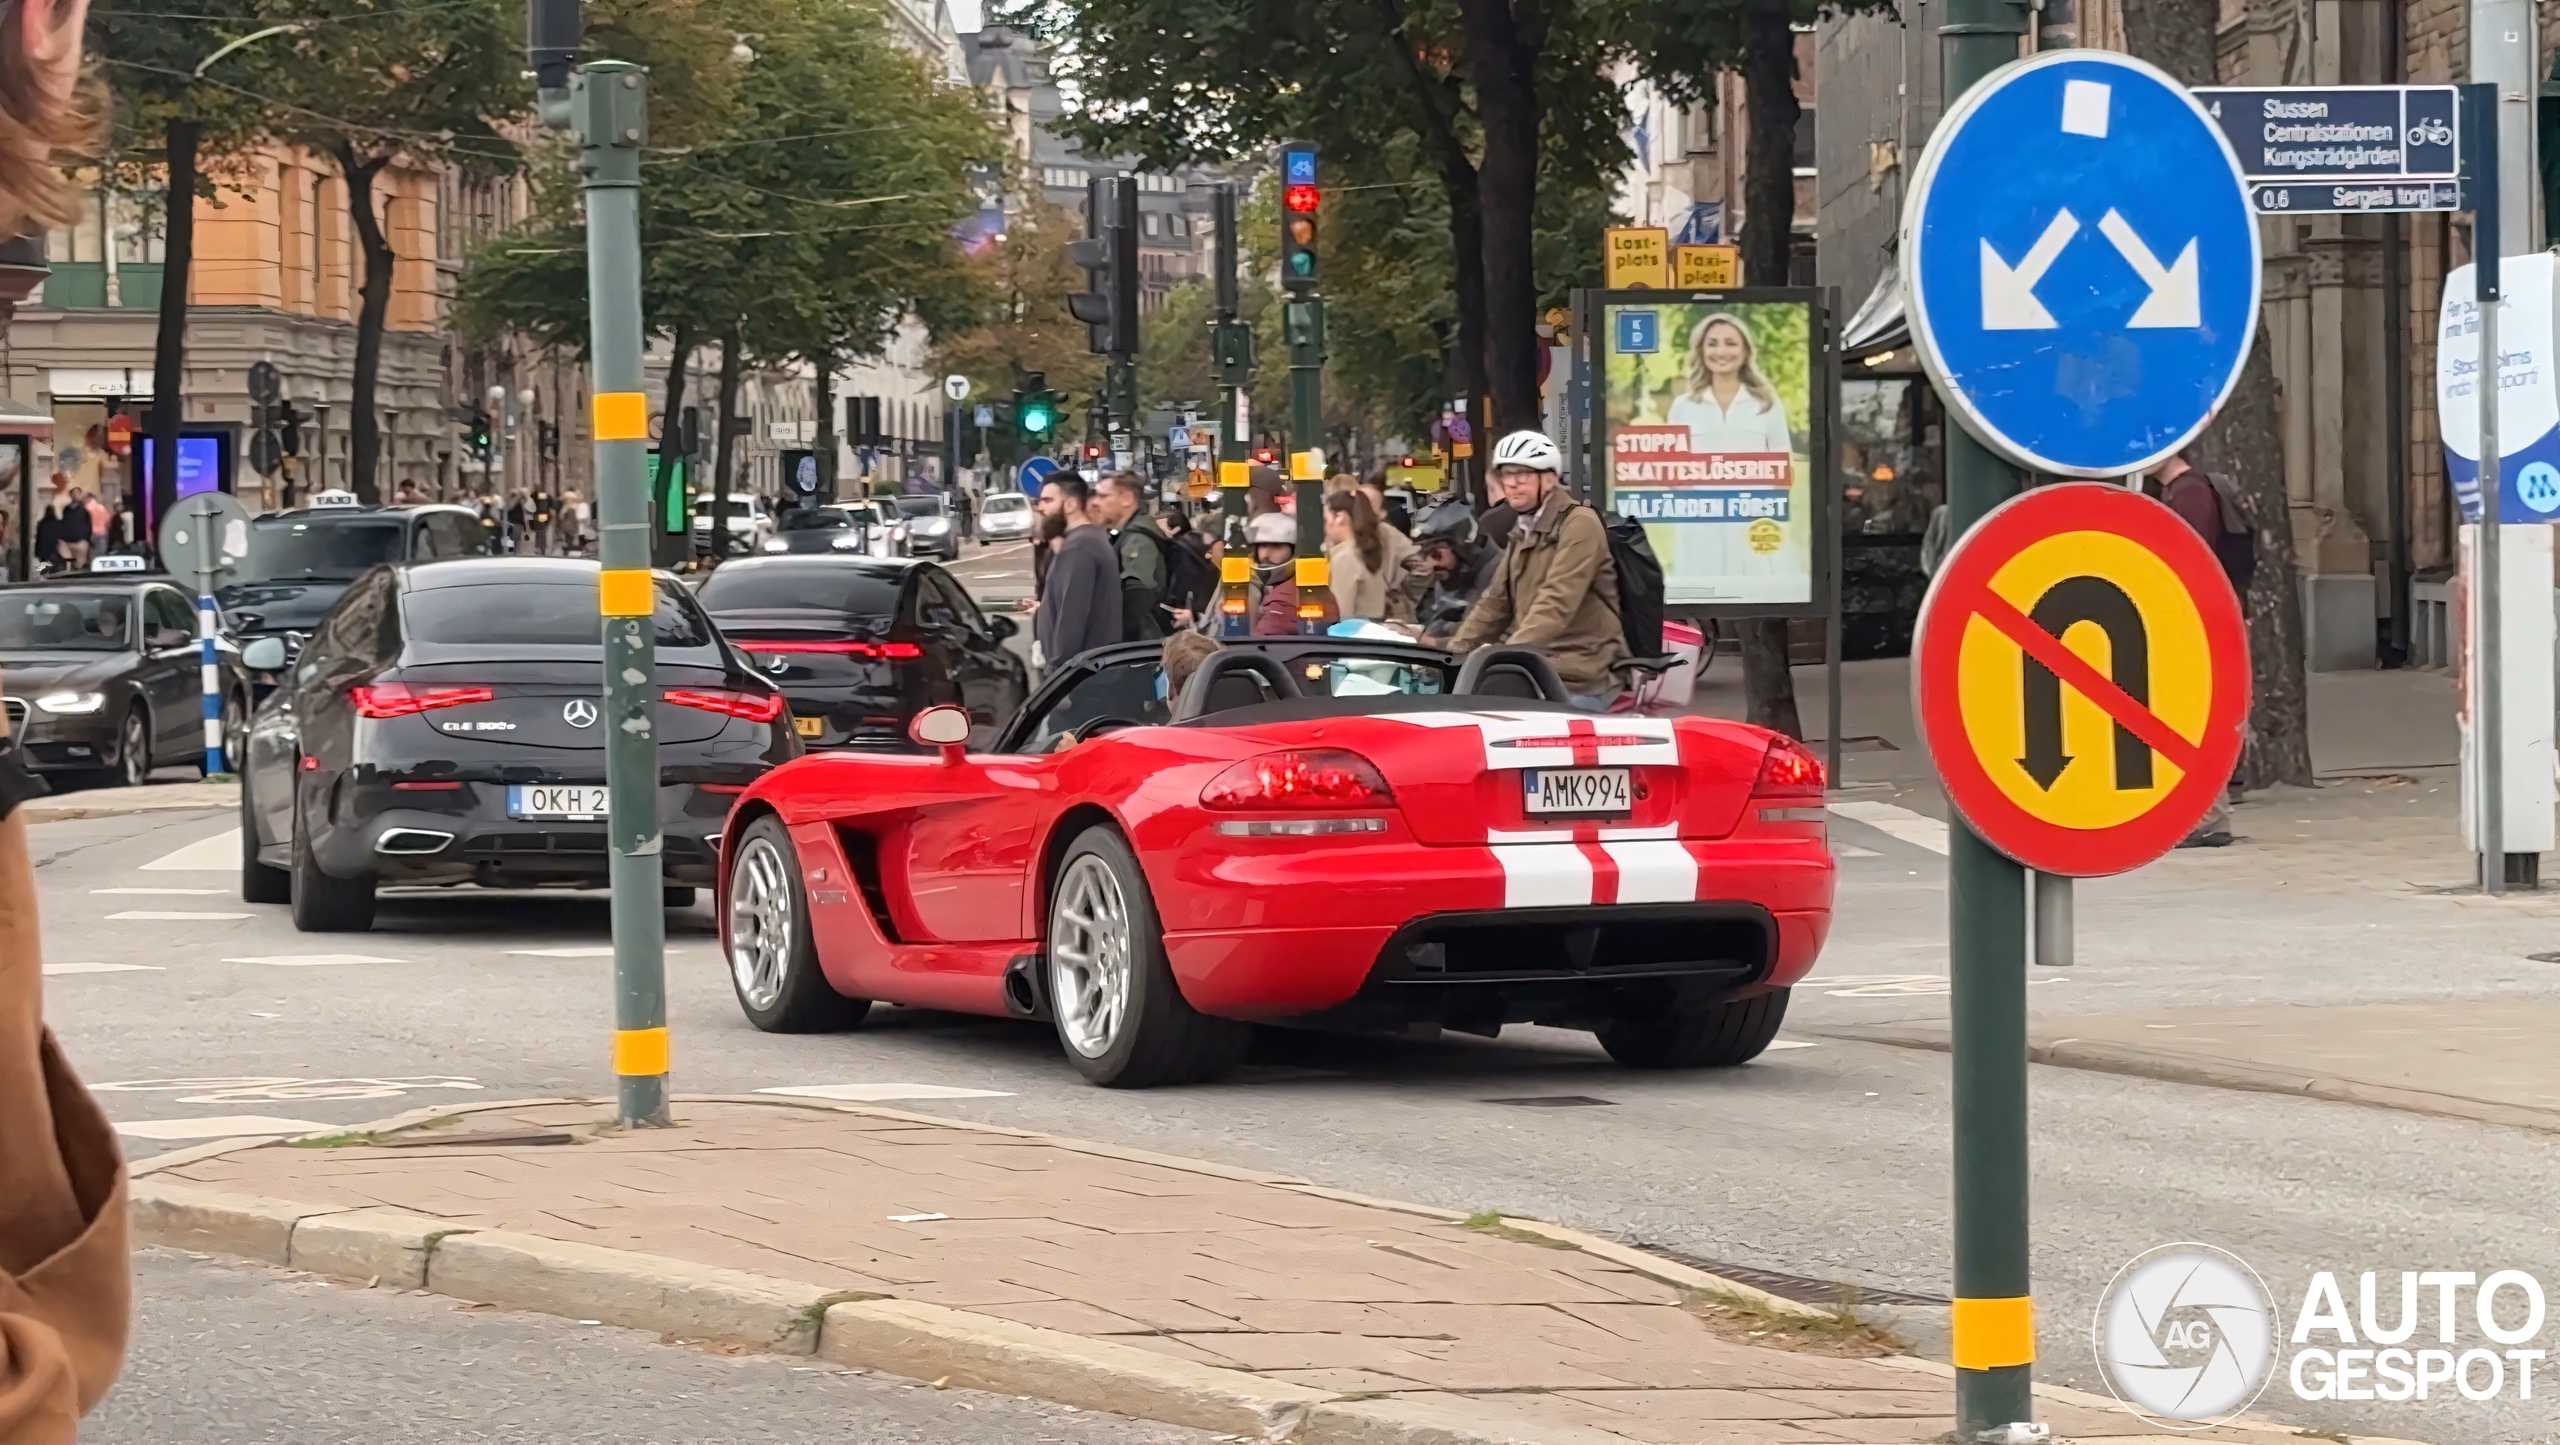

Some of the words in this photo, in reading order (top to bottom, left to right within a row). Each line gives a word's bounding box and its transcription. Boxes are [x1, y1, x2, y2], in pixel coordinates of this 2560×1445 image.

[2263, 98, 2328, 118] Slussen
[2263, 121, 2393, 143] Centralstationen
[2263, 146, 2400, 170] Kungsträdgården
[1615, 433, 1689, 453] STOPPA
[1615, 455, 1788, 481] SKATTESLÖSERIET
[1616, 493, 1725, 519] VÄLFÄRDEN
[1727, 492, 1788, 517] FÖRST
[98, 560, 138, 568] TAXI
[532, 789, 582, 812] OKH
[1542, 774, 1627, 808] AMK994
